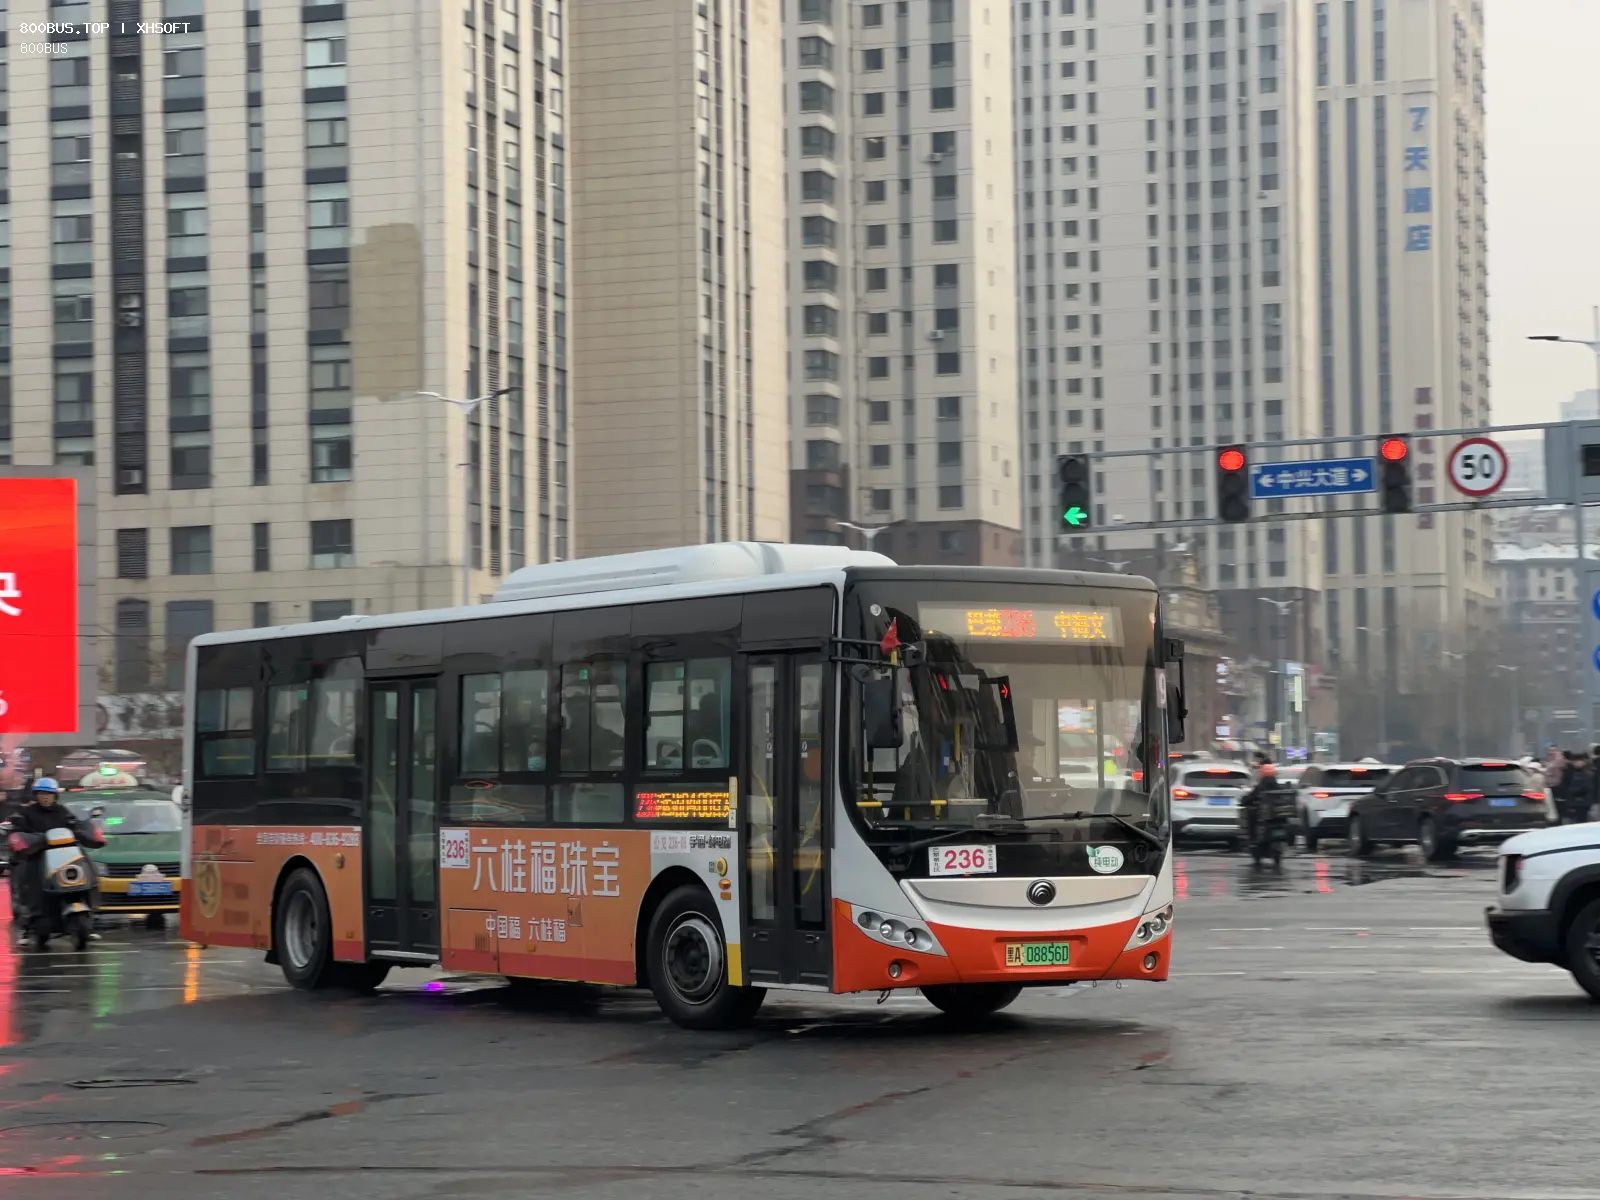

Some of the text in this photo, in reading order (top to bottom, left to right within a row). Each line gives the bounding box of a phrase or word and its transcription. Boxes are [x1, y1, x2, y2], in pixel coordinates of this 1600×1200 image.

[1461, 454, 1495, 480] 50
[1276, 467, 1349, 490] 中兴大道
[446, 839, 465, 858] 236
[944, 848, 985, 870] 236
[472, 838, 620, 896] 六桂福珠宝
[1094, 856, 1119, 867] 纯电动
[486, 915, 567, 942] 中国福 六桂福
[1026, 945, 1069, 962] 08856D
